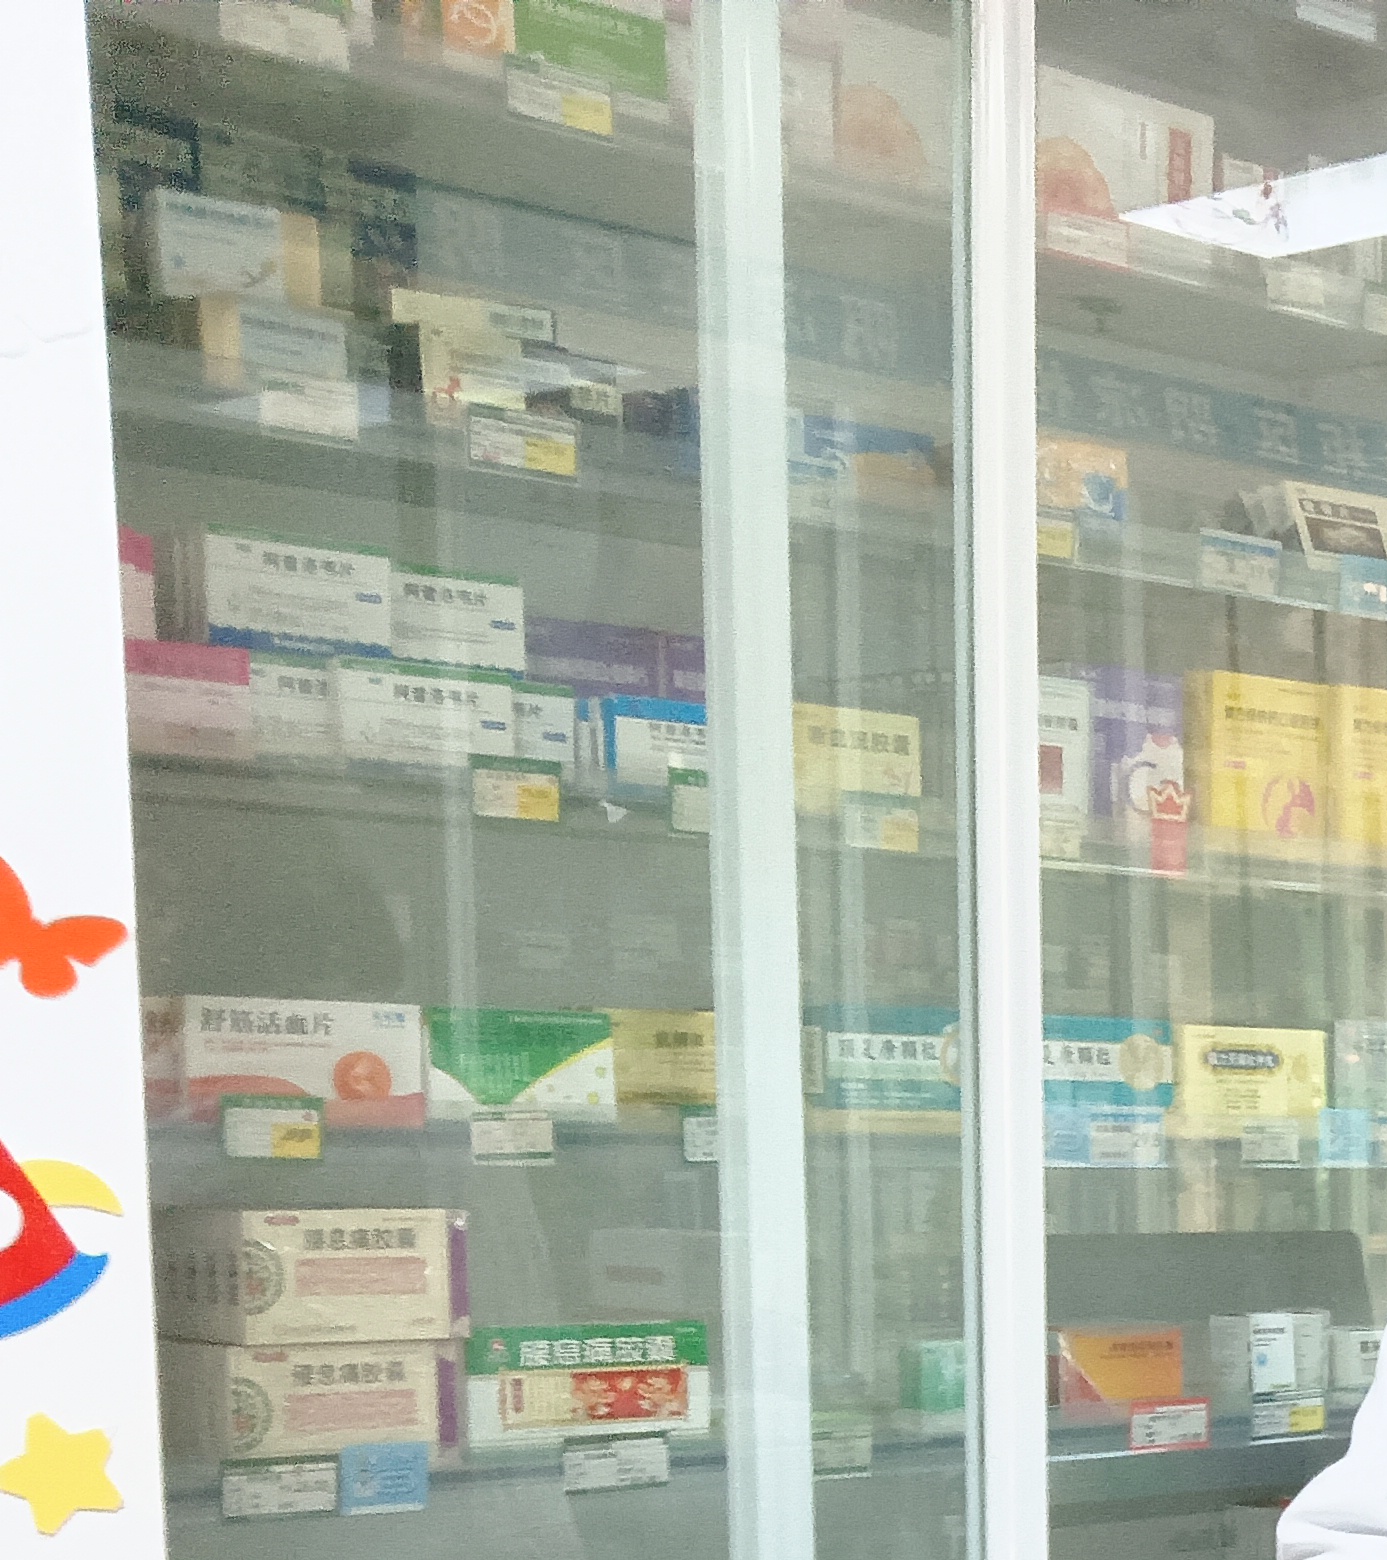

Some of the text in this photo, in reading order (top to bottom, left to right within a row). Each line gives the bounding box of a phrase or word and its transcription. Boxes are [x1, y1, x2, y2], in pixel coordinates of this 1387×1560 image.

[199, 1006, 336, 1038] 舒筋活血片
